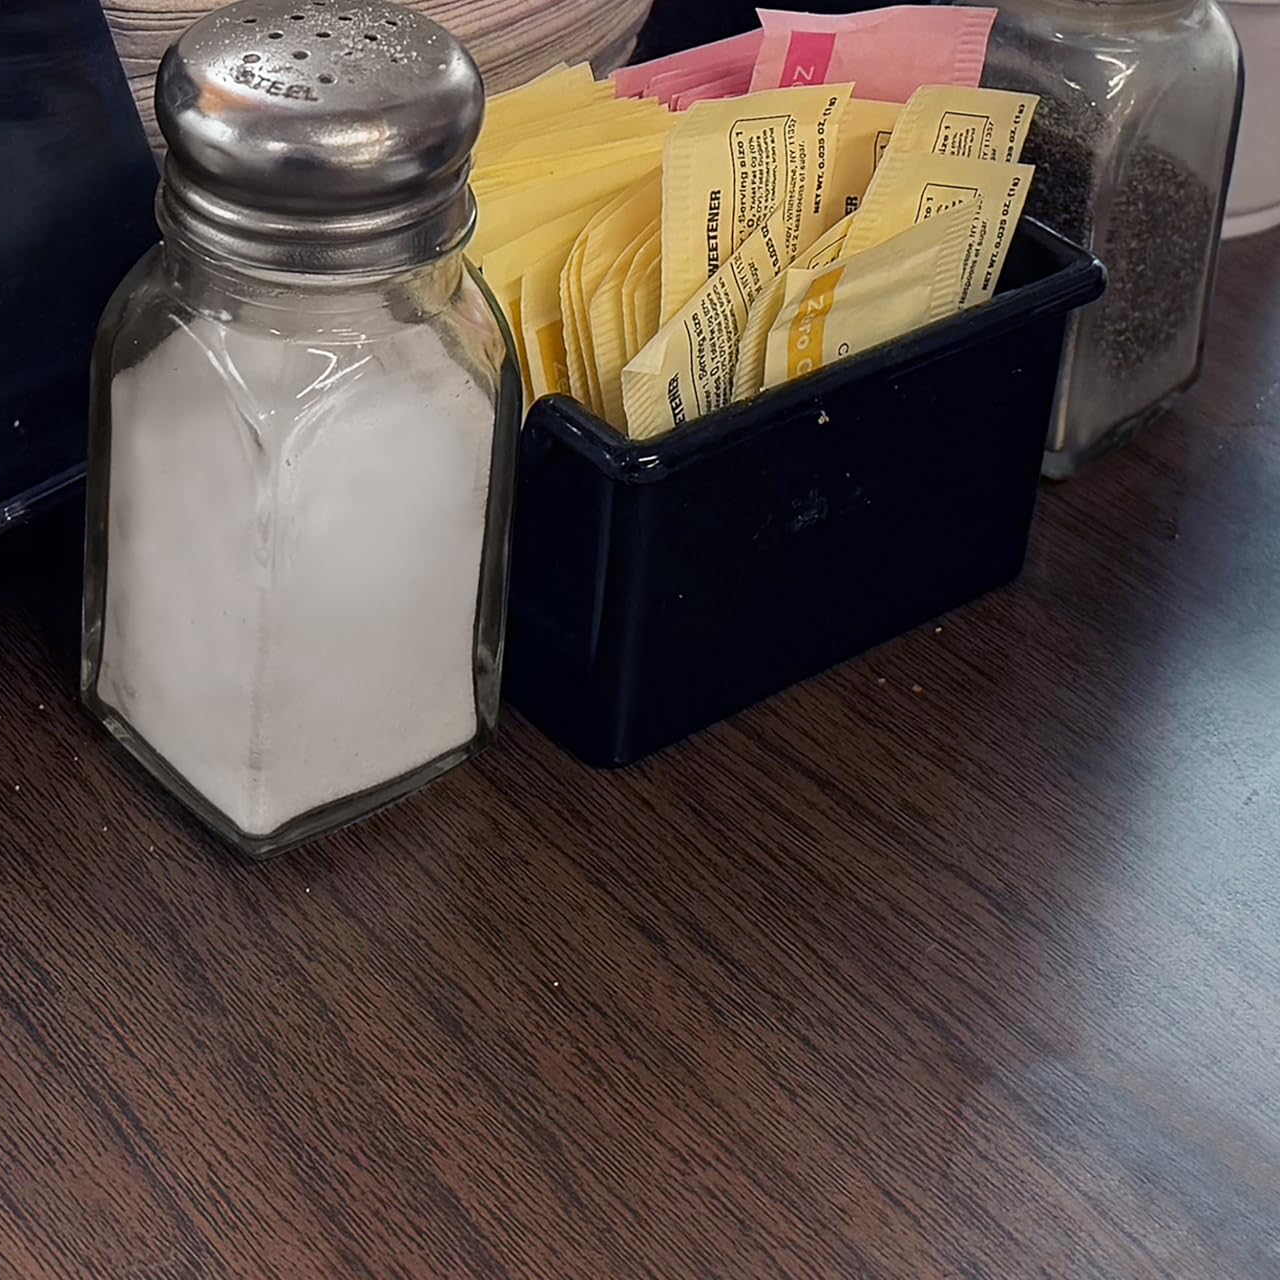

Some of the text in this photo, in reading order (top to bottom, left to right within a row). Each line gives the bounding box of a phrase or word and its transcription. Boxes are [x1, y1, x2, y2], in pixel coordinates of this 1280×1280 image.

[813, 194, 821, 214] NET
[707, 189, 721, 280] WEETENER
[667, 372, 687, 426] ETENER
